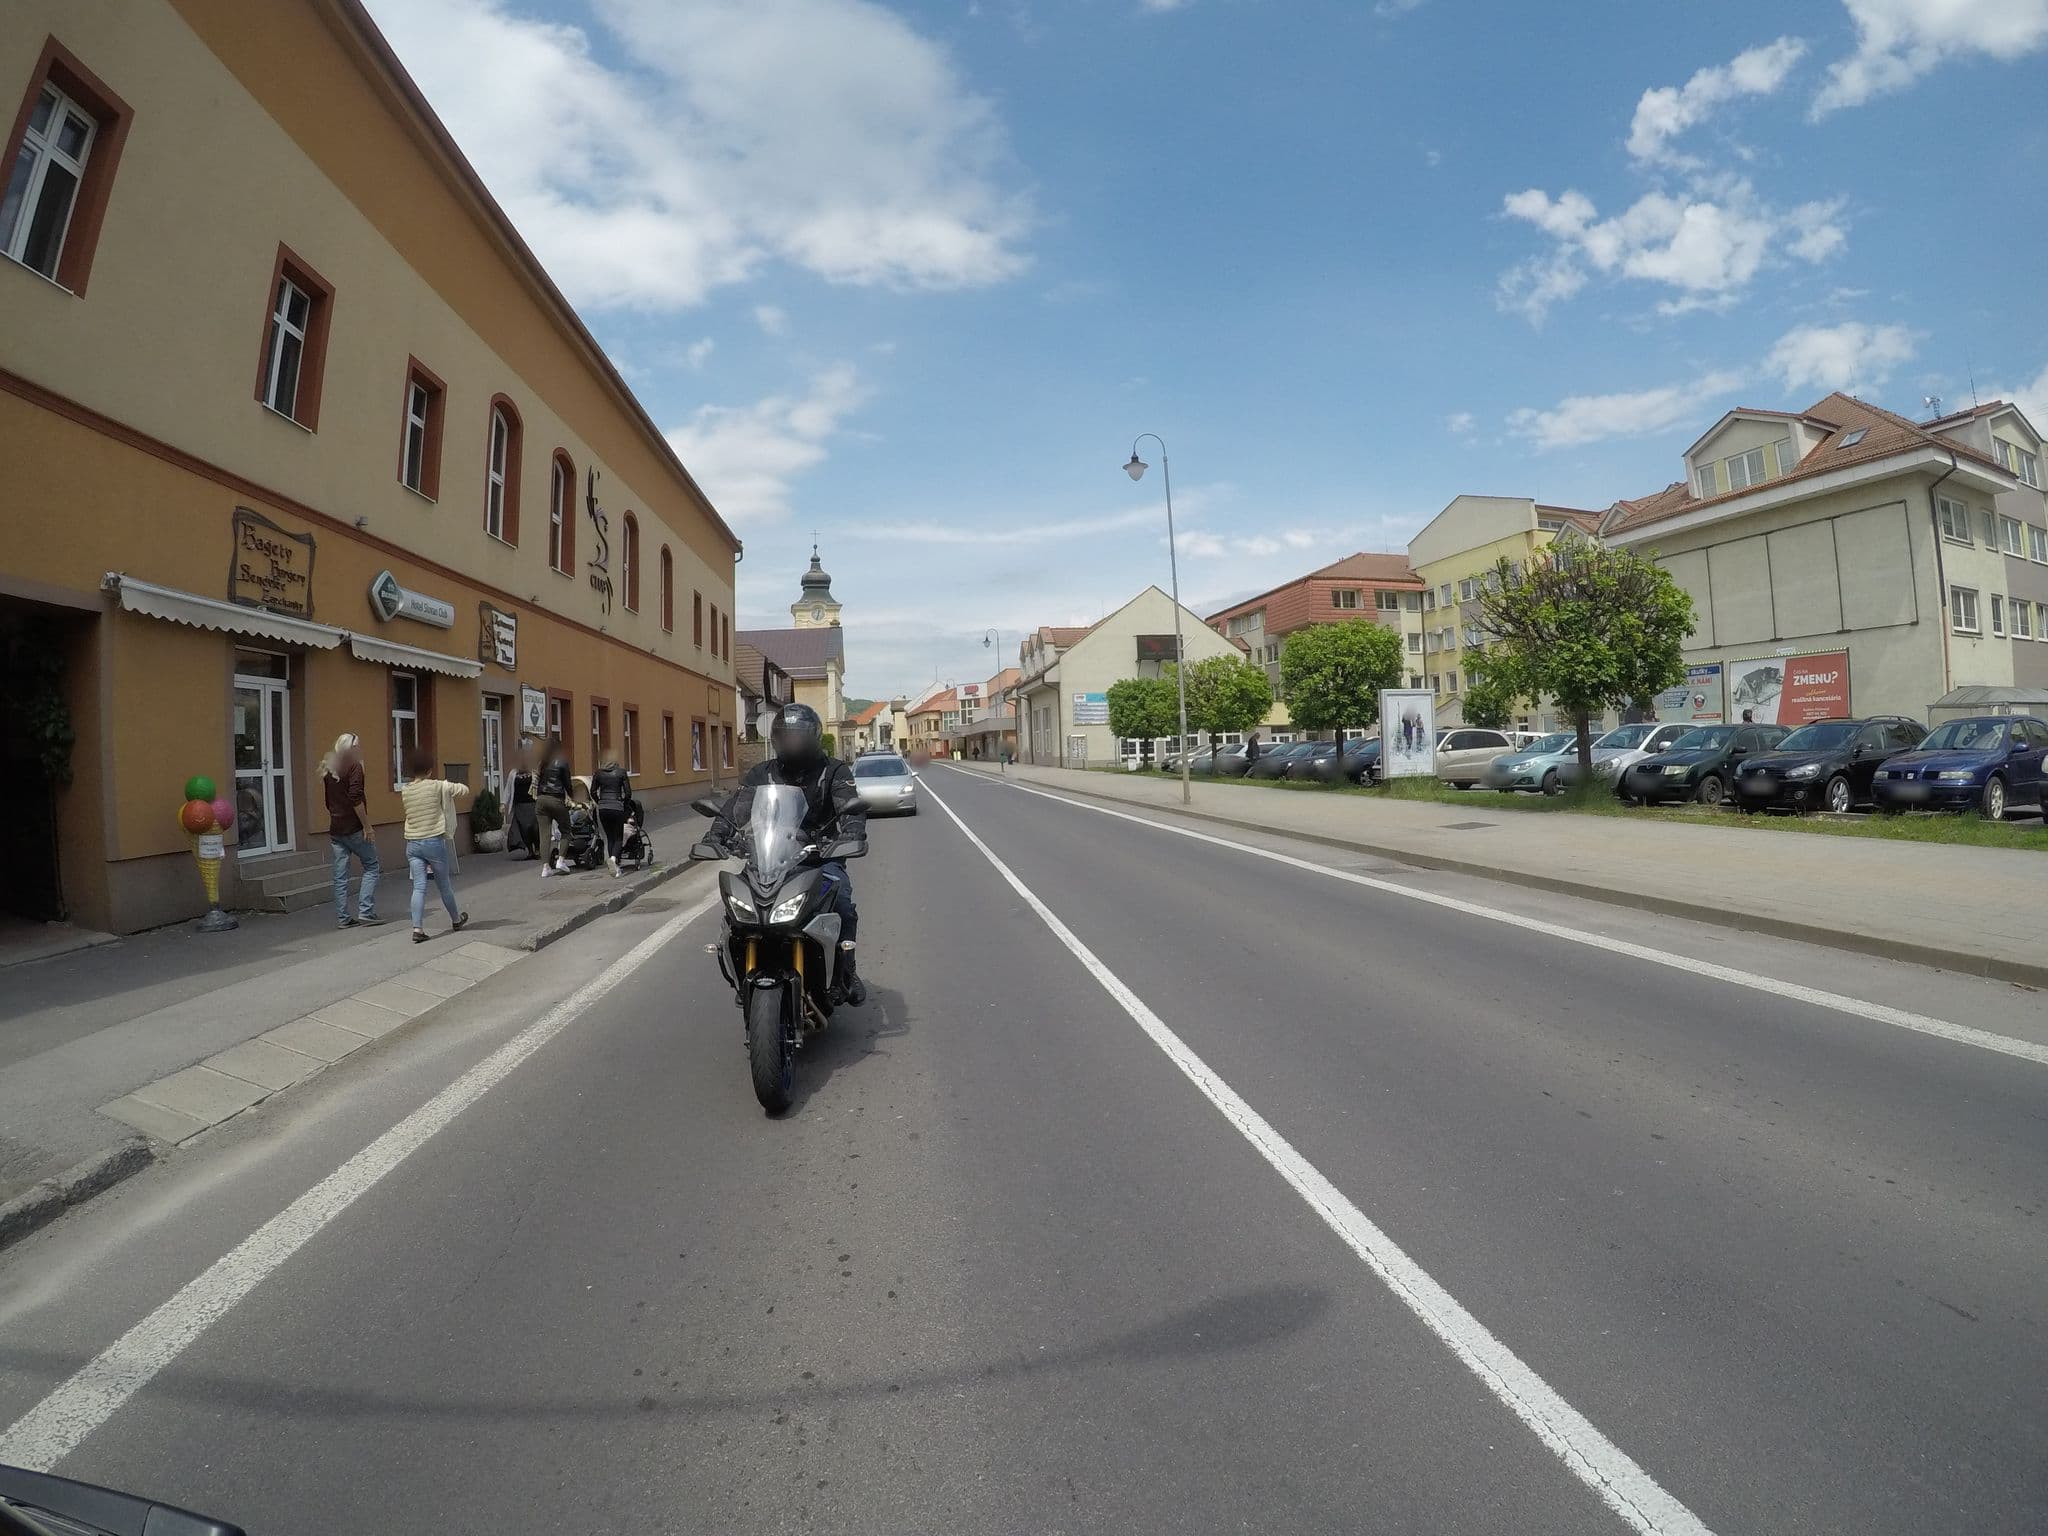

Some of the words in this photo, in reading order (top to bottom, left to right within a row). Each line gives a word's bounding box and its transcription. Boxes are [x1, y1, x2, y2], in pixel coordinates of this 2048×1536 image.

[241, 521, 293, 563] Bagety
[270, 558, 306, 587] Burgery
[1792, 670, 1839, 686] ZMENU?
